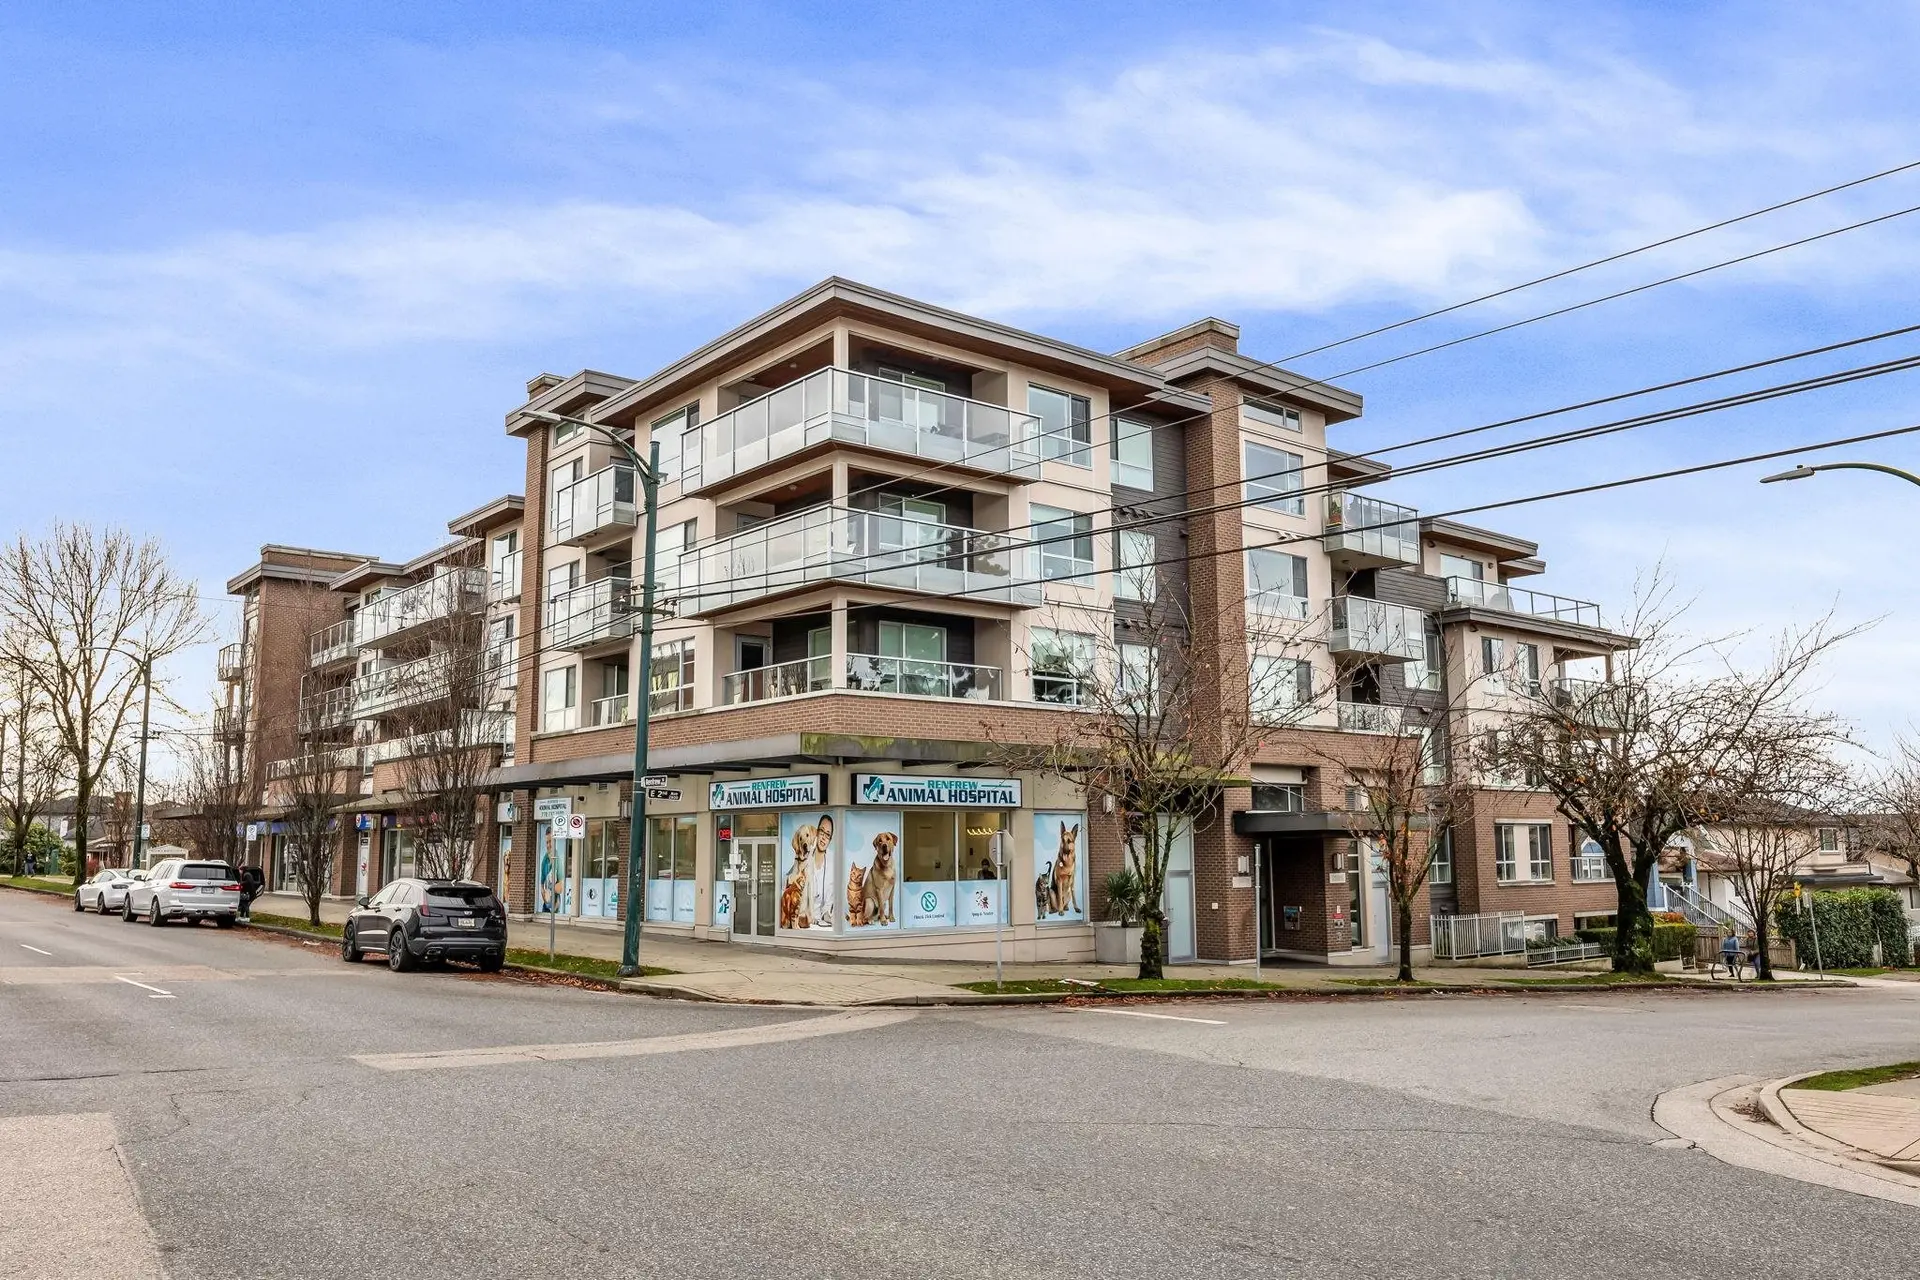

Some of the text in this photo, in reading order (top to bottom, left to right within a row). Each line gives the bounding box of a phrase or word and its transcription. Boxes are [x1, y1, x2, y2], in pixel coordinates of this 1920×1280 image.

[752, 779, 788, 791] RENFREW
[927, 779, 979, 790] RENFREW
[650, 789, 656, 797] E
[726, 787, 816, 805] ANIMAL HOSPITAL
[886, 787, 1017, 804] ANIMAL HOSPITAL
